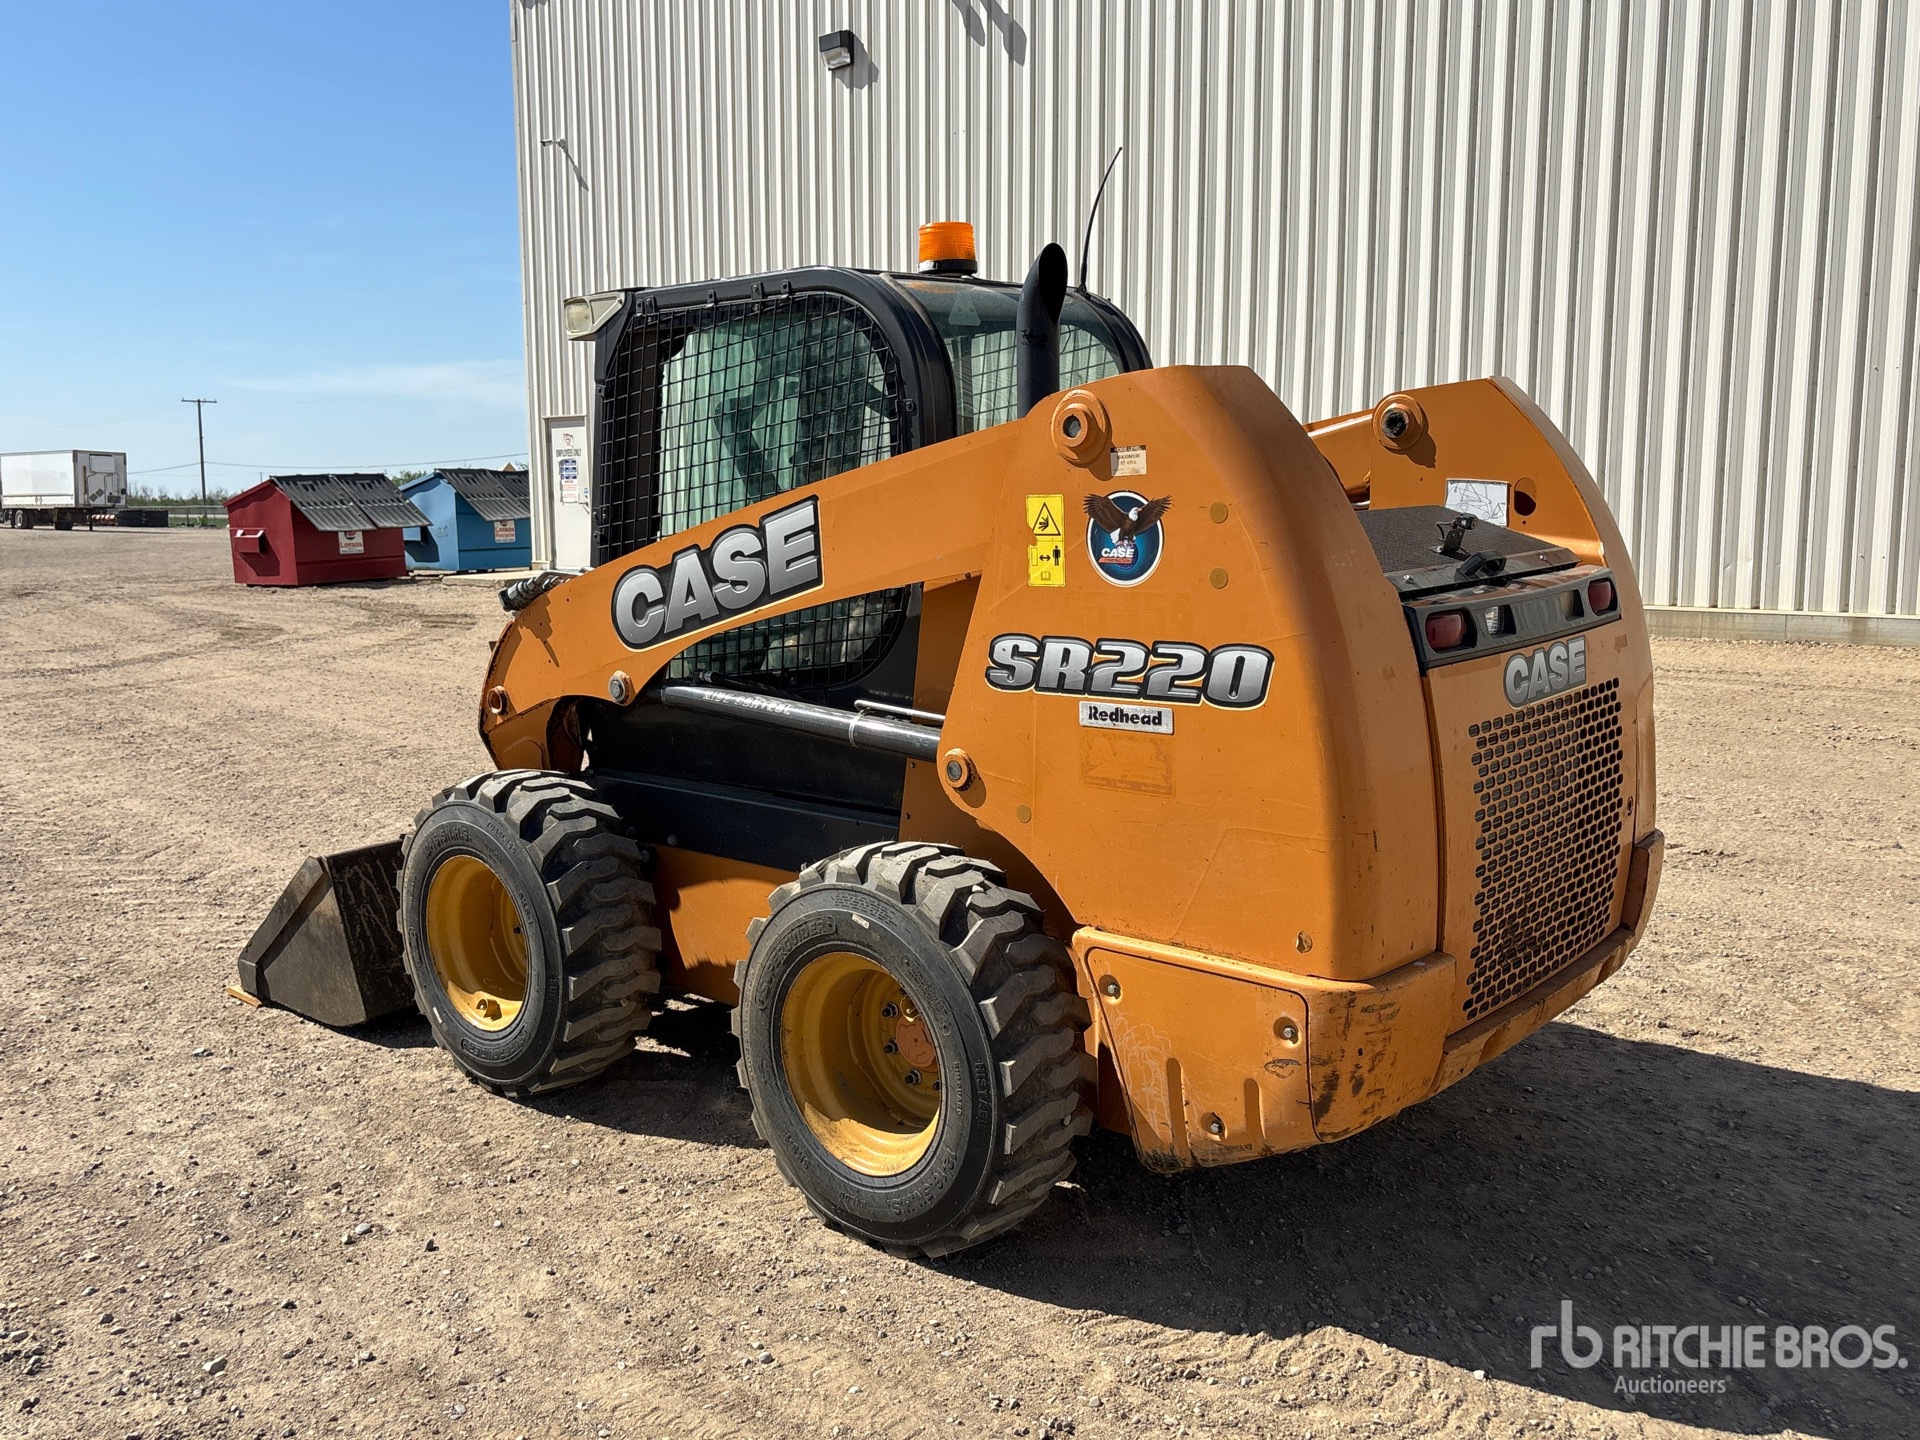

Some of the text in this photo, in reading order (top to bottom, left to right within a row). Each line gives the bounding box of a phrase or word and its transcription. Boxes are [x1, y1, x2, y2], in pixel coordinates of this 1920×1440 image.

[612, 495, 824, 652] CASE
[1101, 547, 1135, 558] CASE
[984, 632, 1275, 711] SR220
[1504, 636, 1587, 709] CASE
[1088, 705, 1163, 727] Redhead
